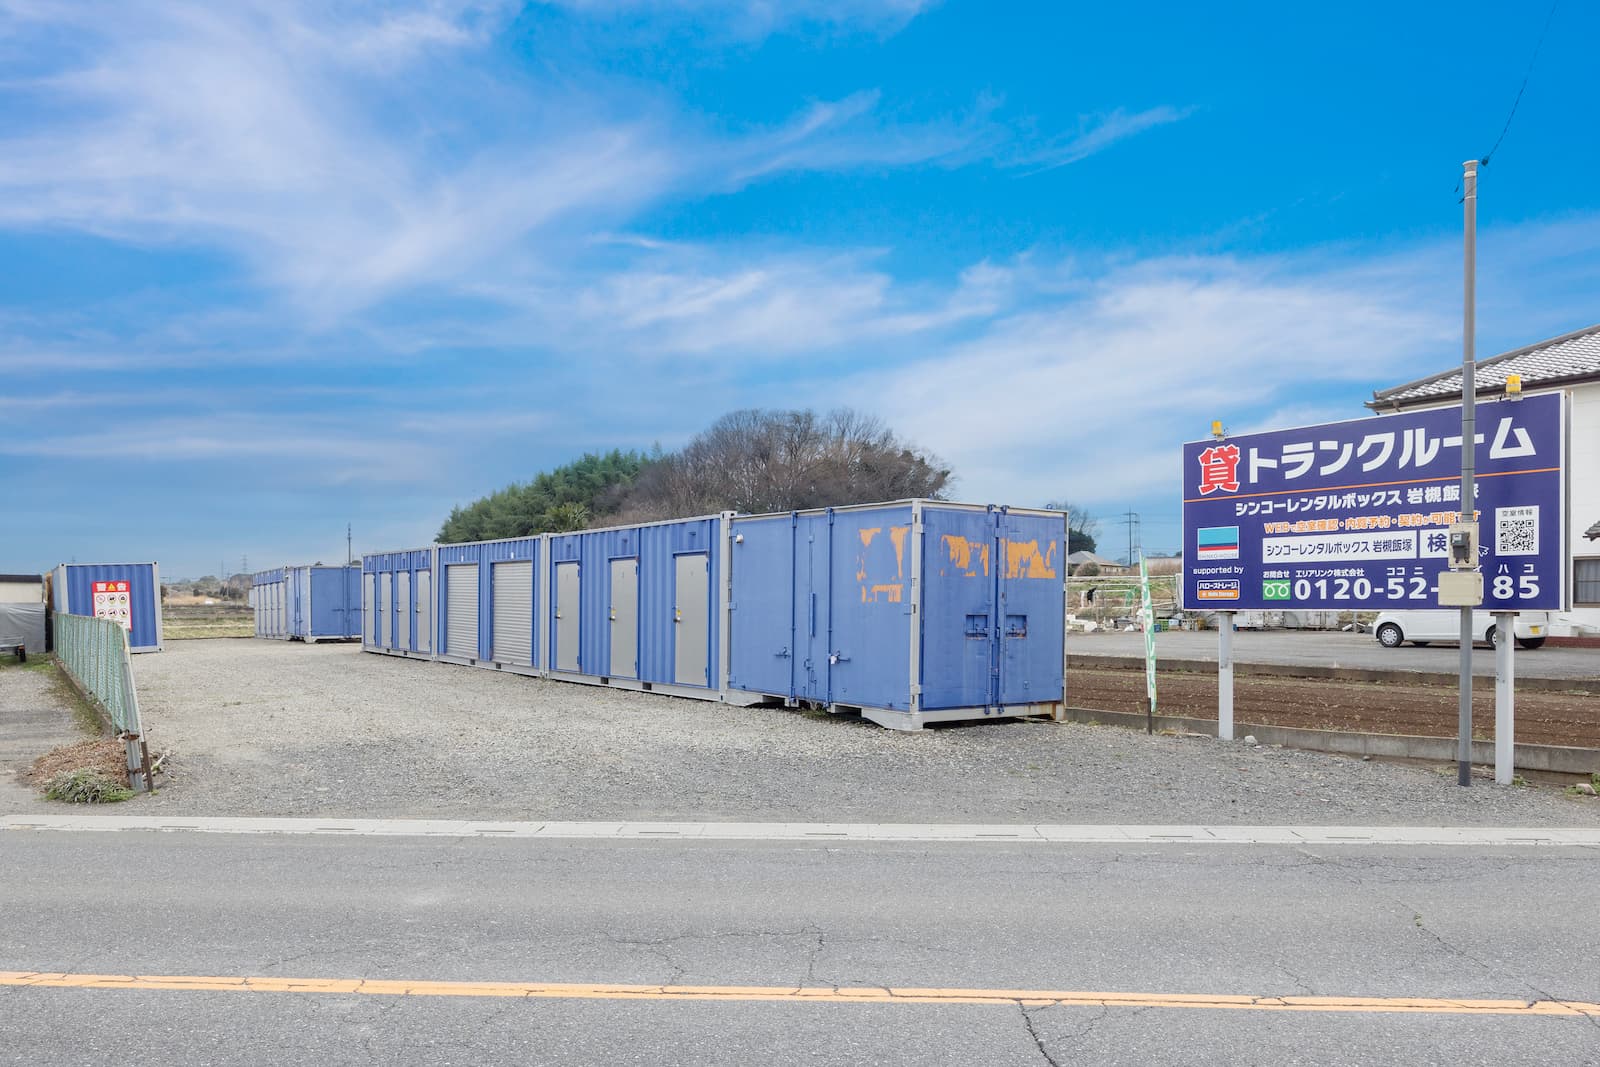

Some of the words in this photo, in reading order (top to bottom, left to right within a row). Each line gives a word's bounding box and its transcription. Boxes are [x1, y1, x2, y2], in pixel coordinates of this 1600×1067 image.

[1235, 489, 1402, 517] シンコーレンタルボックス
[1266, 541, 1370, 557] シンコーレンタルボックス
[1373, 538, 1413, 553] 岩槻飯塚
[1427, 533, 1447, 552] 検
[1193, 566, 1232, 576] supported
[1234, 566, 1244, 575] by
[1263, 570, 1290, 579] お問合せ
[1295, 568, 1365, 578] エリアリンク株式会社
